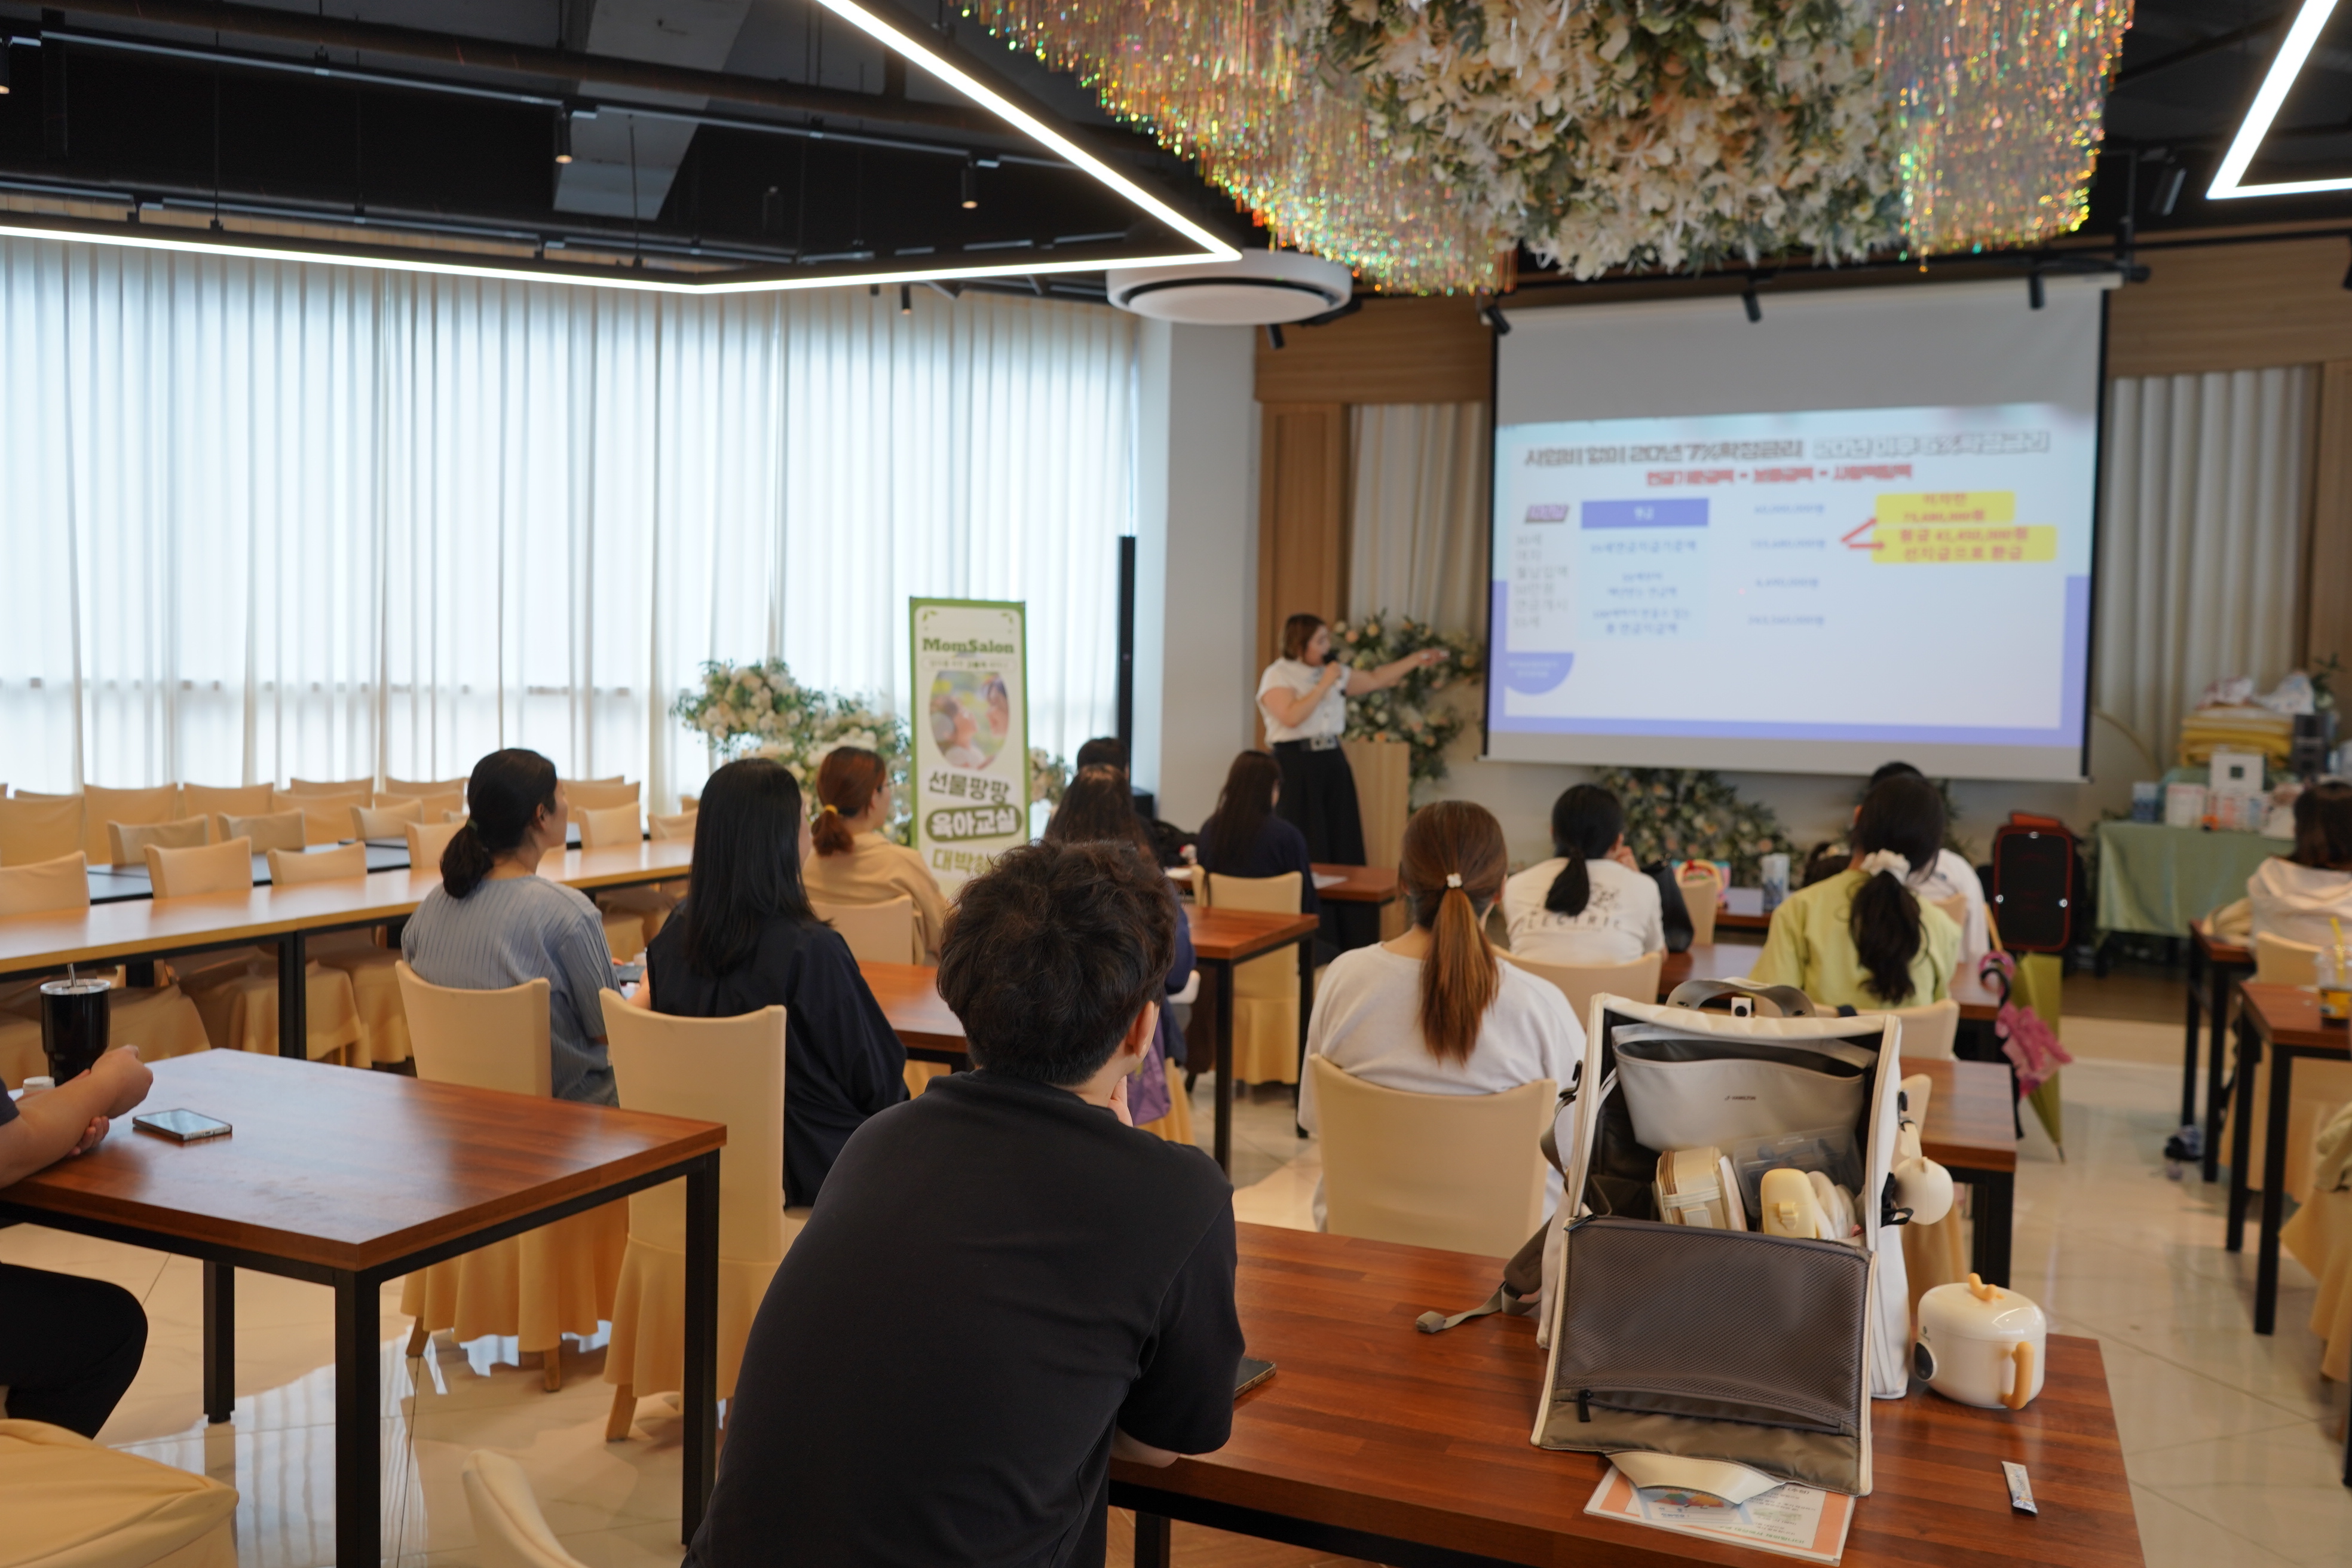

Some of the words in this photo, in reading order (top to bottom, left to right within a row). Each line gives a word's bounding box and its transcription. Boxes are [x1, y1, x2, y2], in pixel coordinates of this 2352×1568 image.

[923, 638, 1014, 654] MomSalon
[929, 770, 1010, 804] 선물팡팡
[931, 807, 1016, 838] 육아교실
